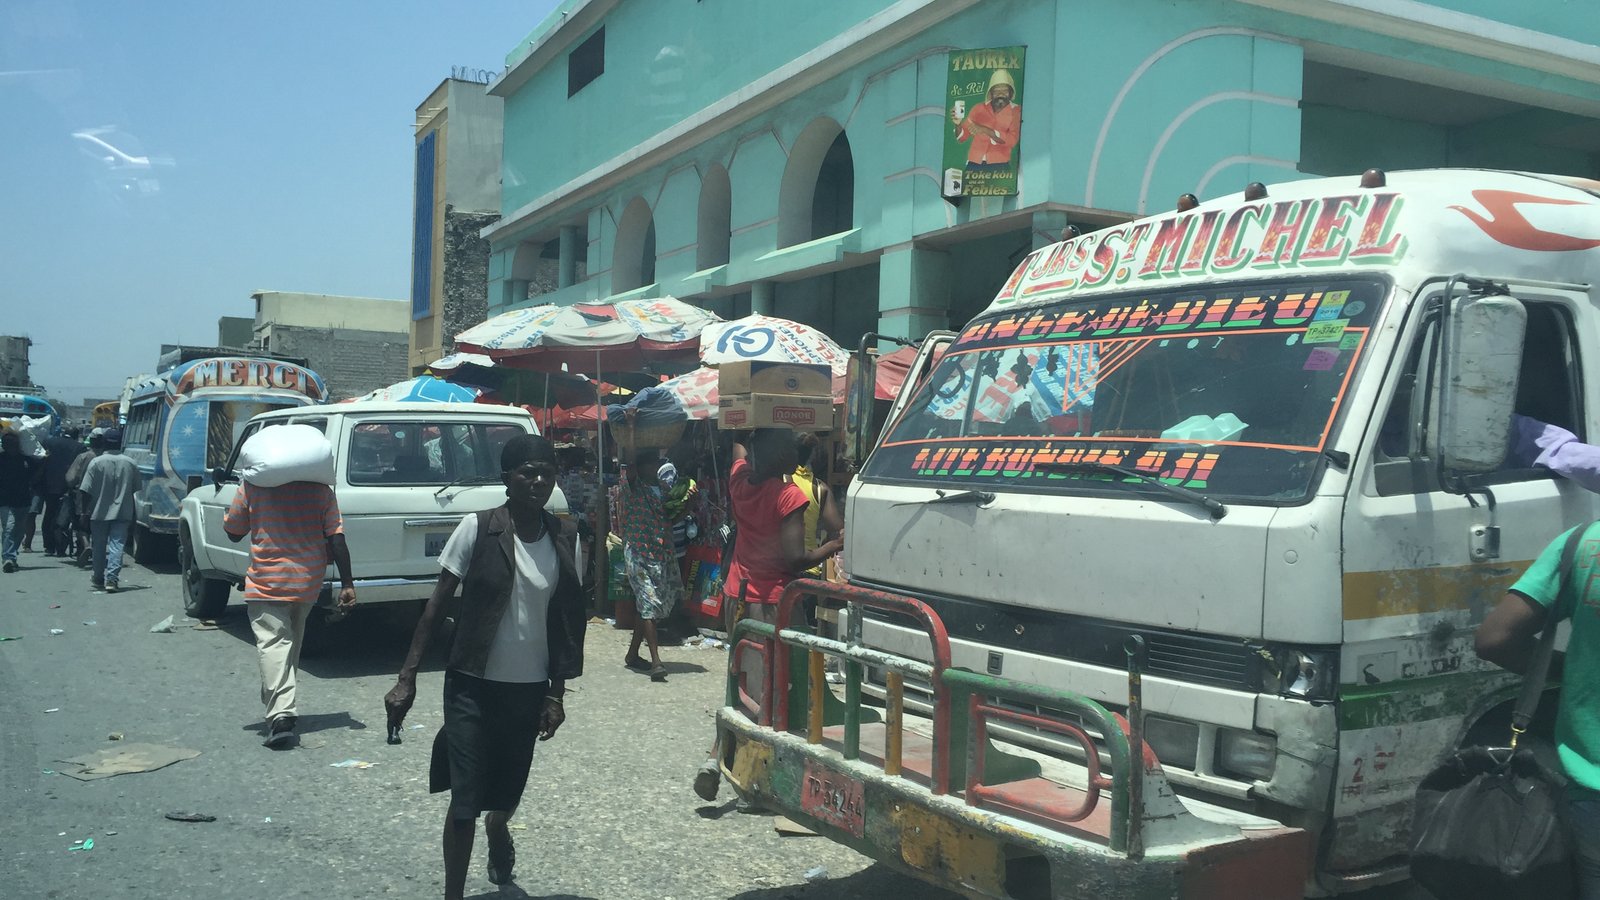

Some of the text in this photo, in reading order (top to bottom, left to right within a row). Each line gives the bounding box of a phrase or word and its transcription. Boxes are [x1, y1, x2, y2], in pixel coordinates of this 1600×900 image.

[953, 52, 1020, 71] TAUREX
[1138, 193, 1409, 279] MICHEL
[193, 360, 307, 395] MERCI
